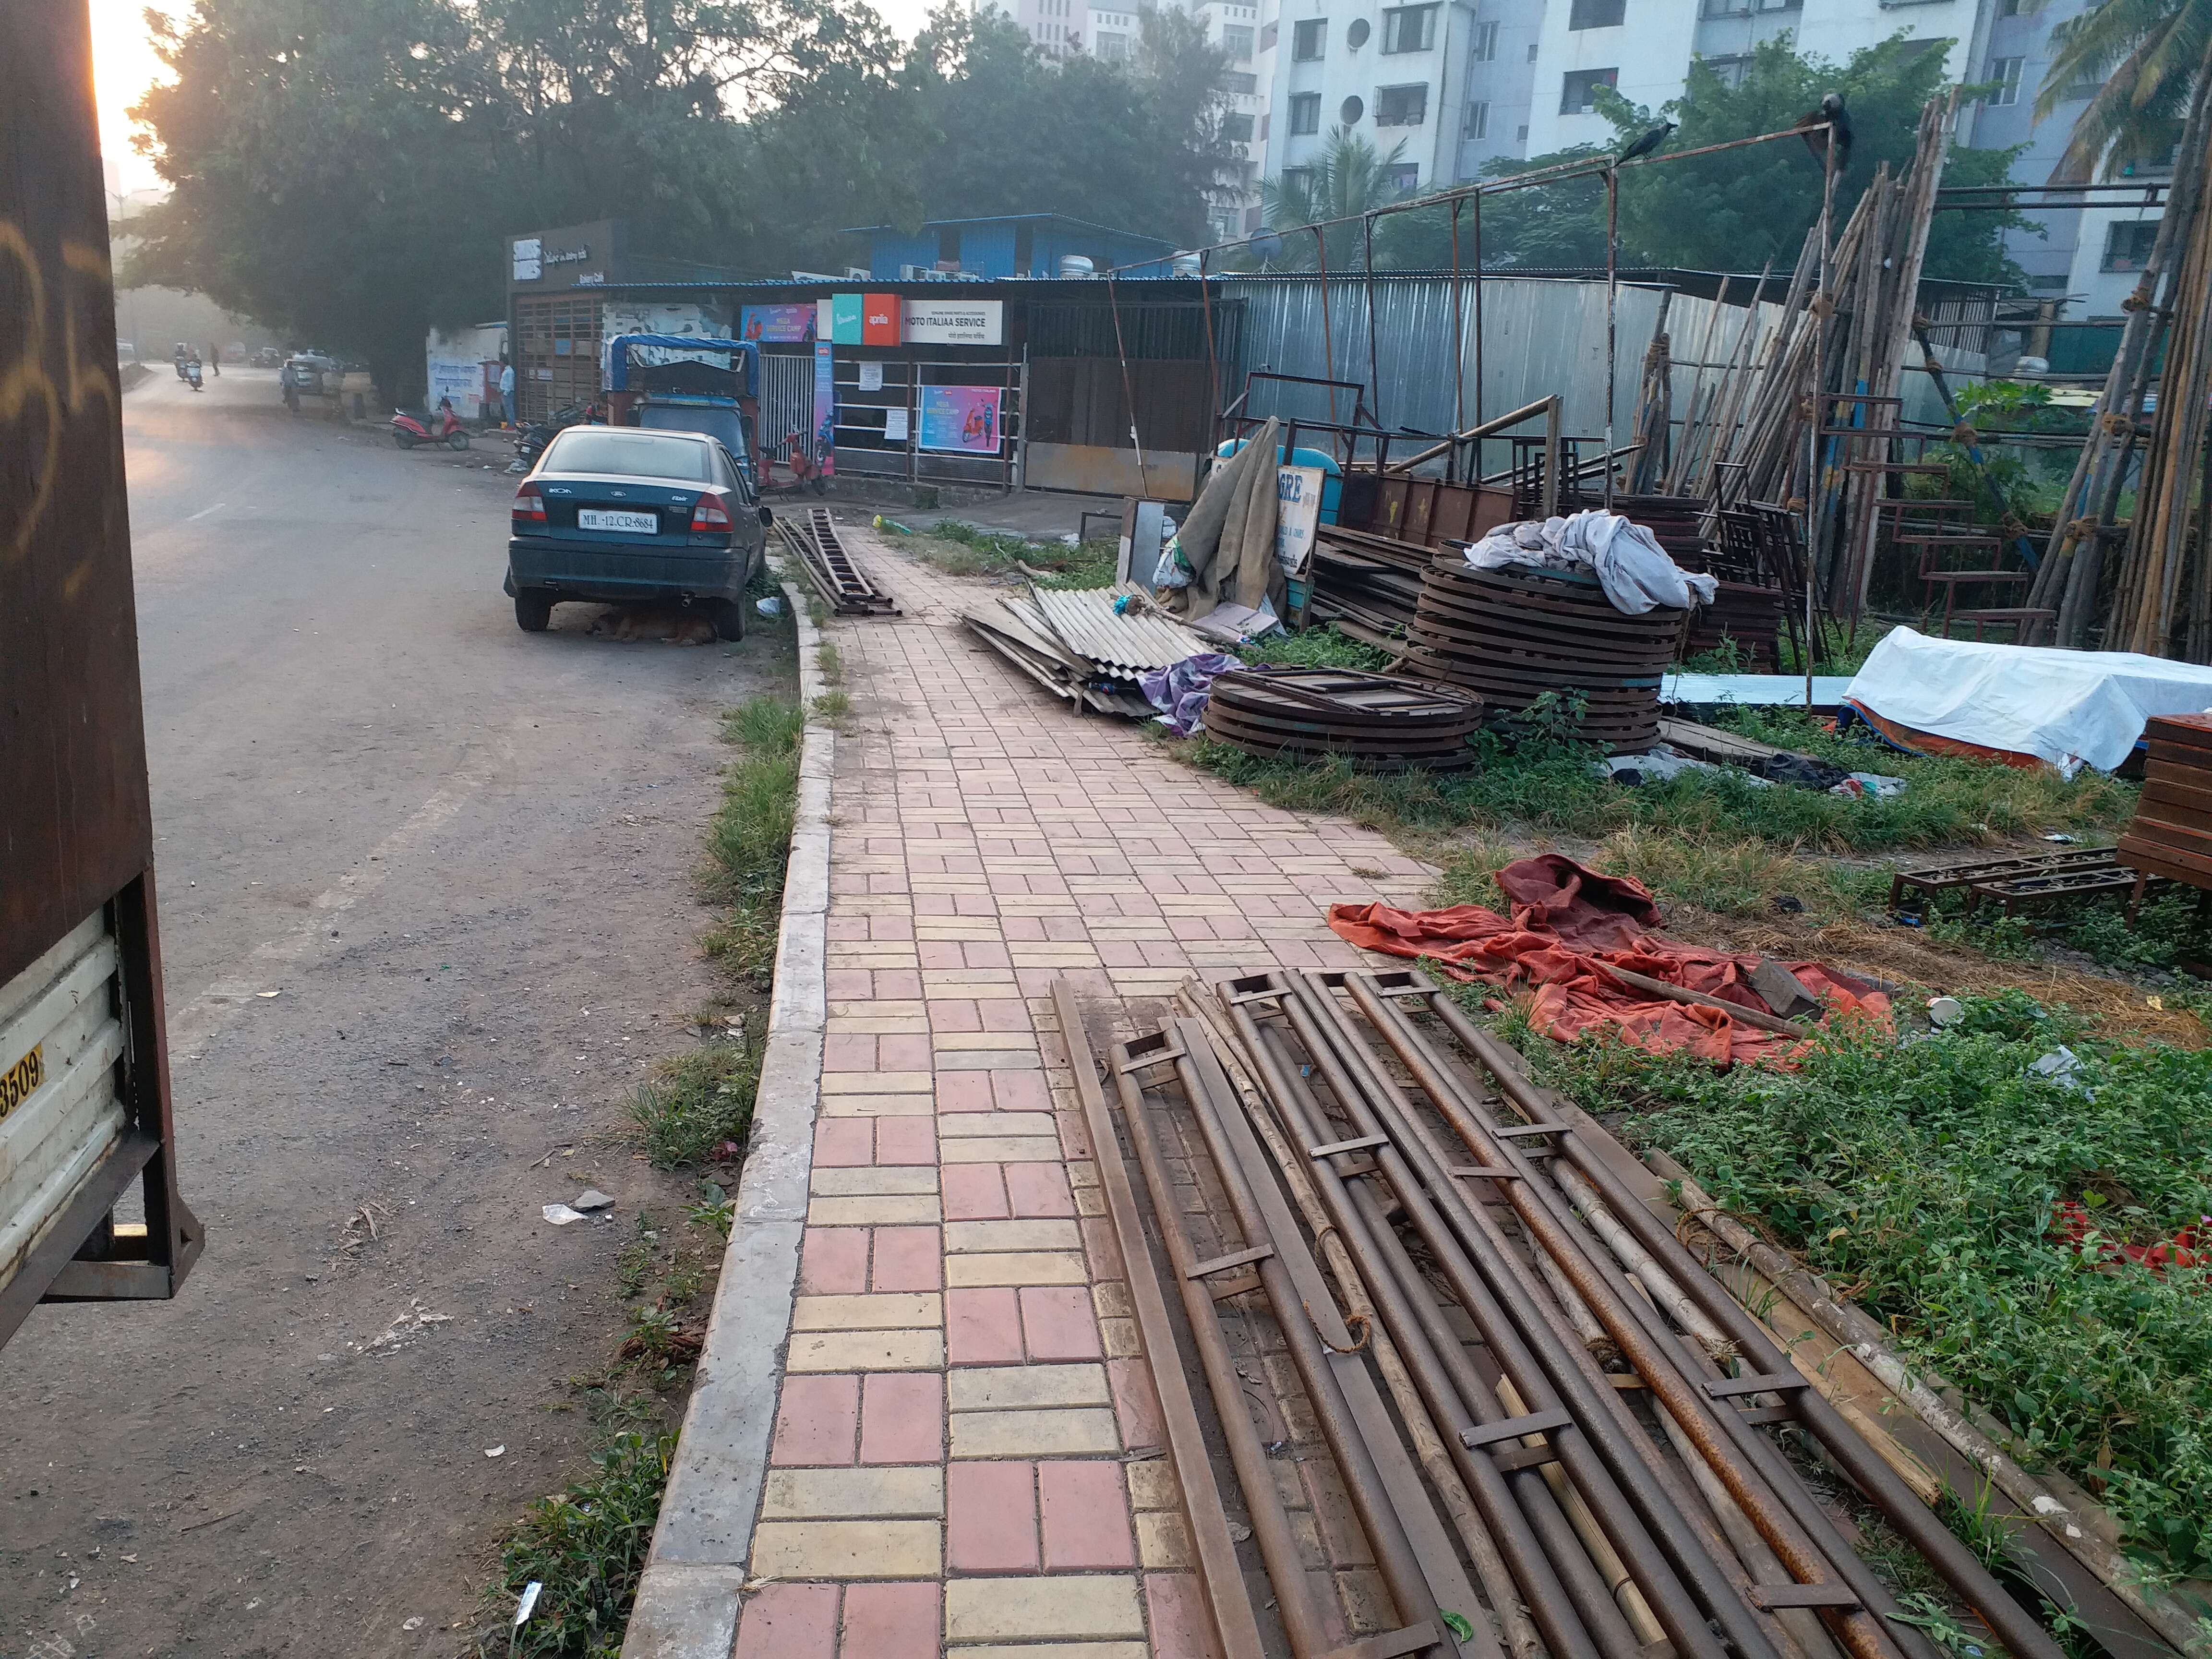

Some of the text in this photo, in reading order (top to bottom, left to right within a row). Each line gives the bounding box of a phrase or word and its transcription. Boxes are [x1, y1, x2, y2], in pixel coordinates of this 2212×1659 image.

[905, 317, 986, 327] MOTO ITALIAA SERVICE
[0, 1051, 38, 1118] 3509
